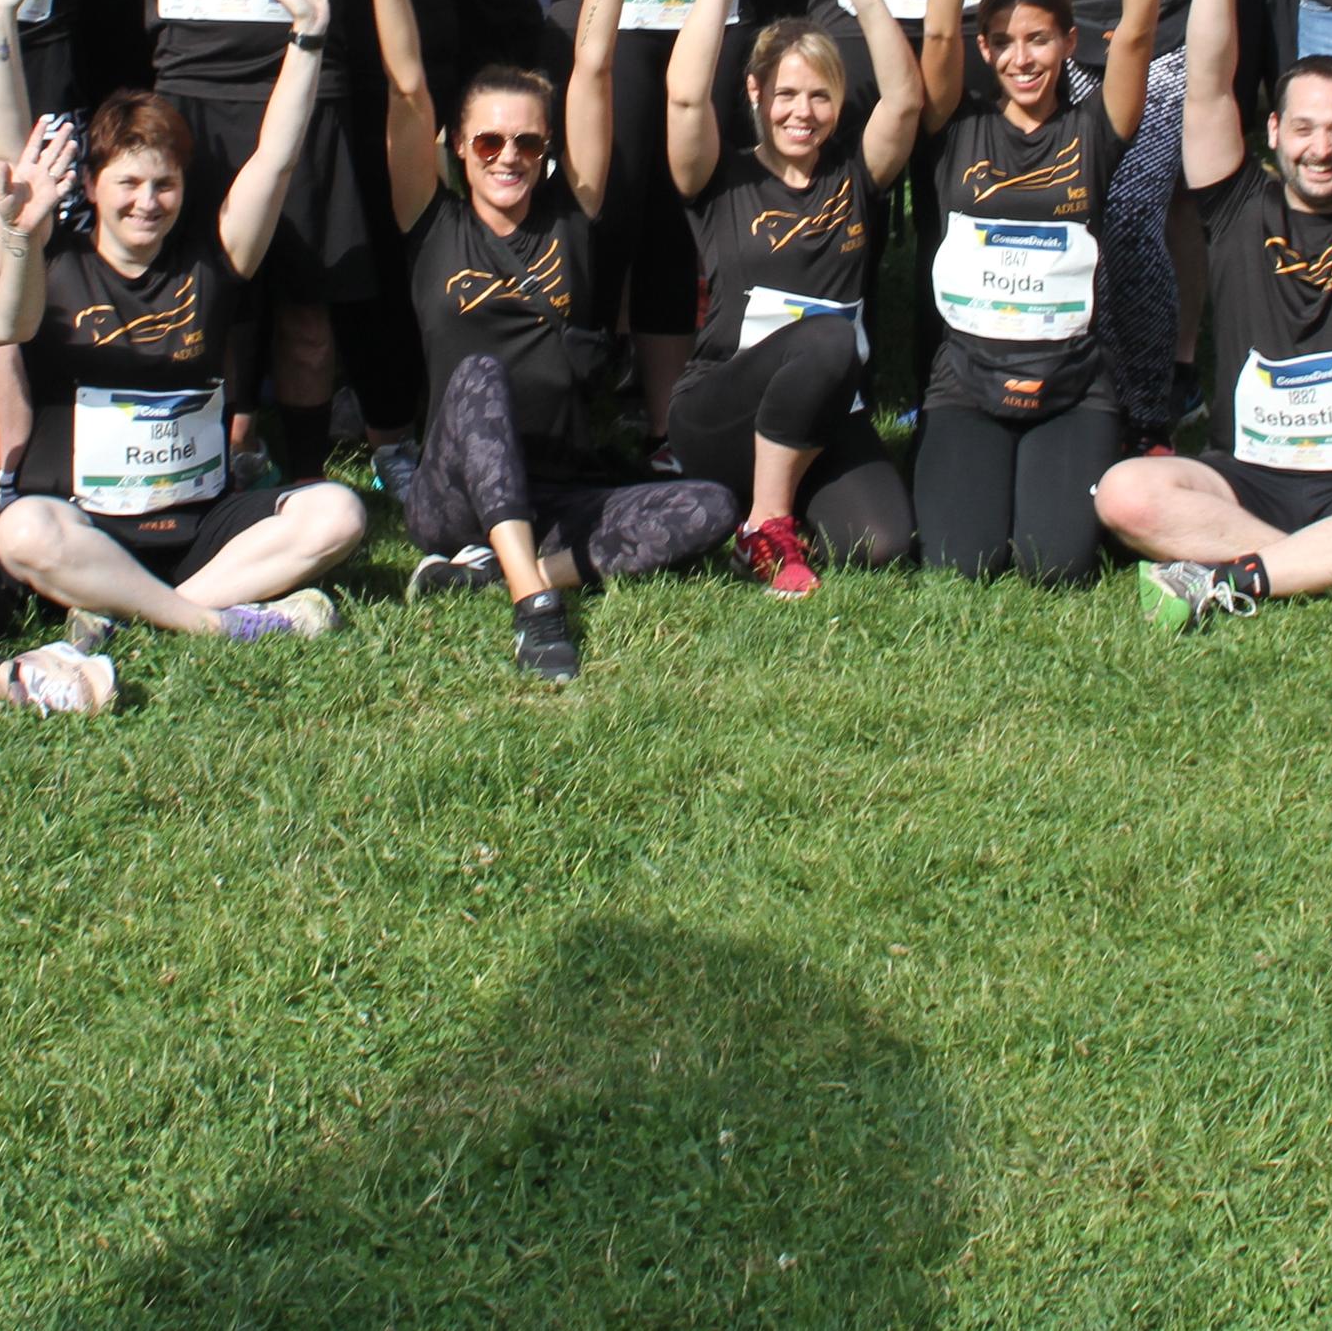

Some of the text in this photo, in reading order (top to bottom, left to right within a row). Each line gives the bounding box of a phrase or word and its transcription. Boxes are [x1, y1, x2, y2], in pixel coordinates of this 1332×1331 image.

[1000, 250, 1029, 267] 1847
[982, 270, 1045, 295] Rojda
[150, 420, 179, 441] 1840
[125, 436, 197, 465] Rachel
